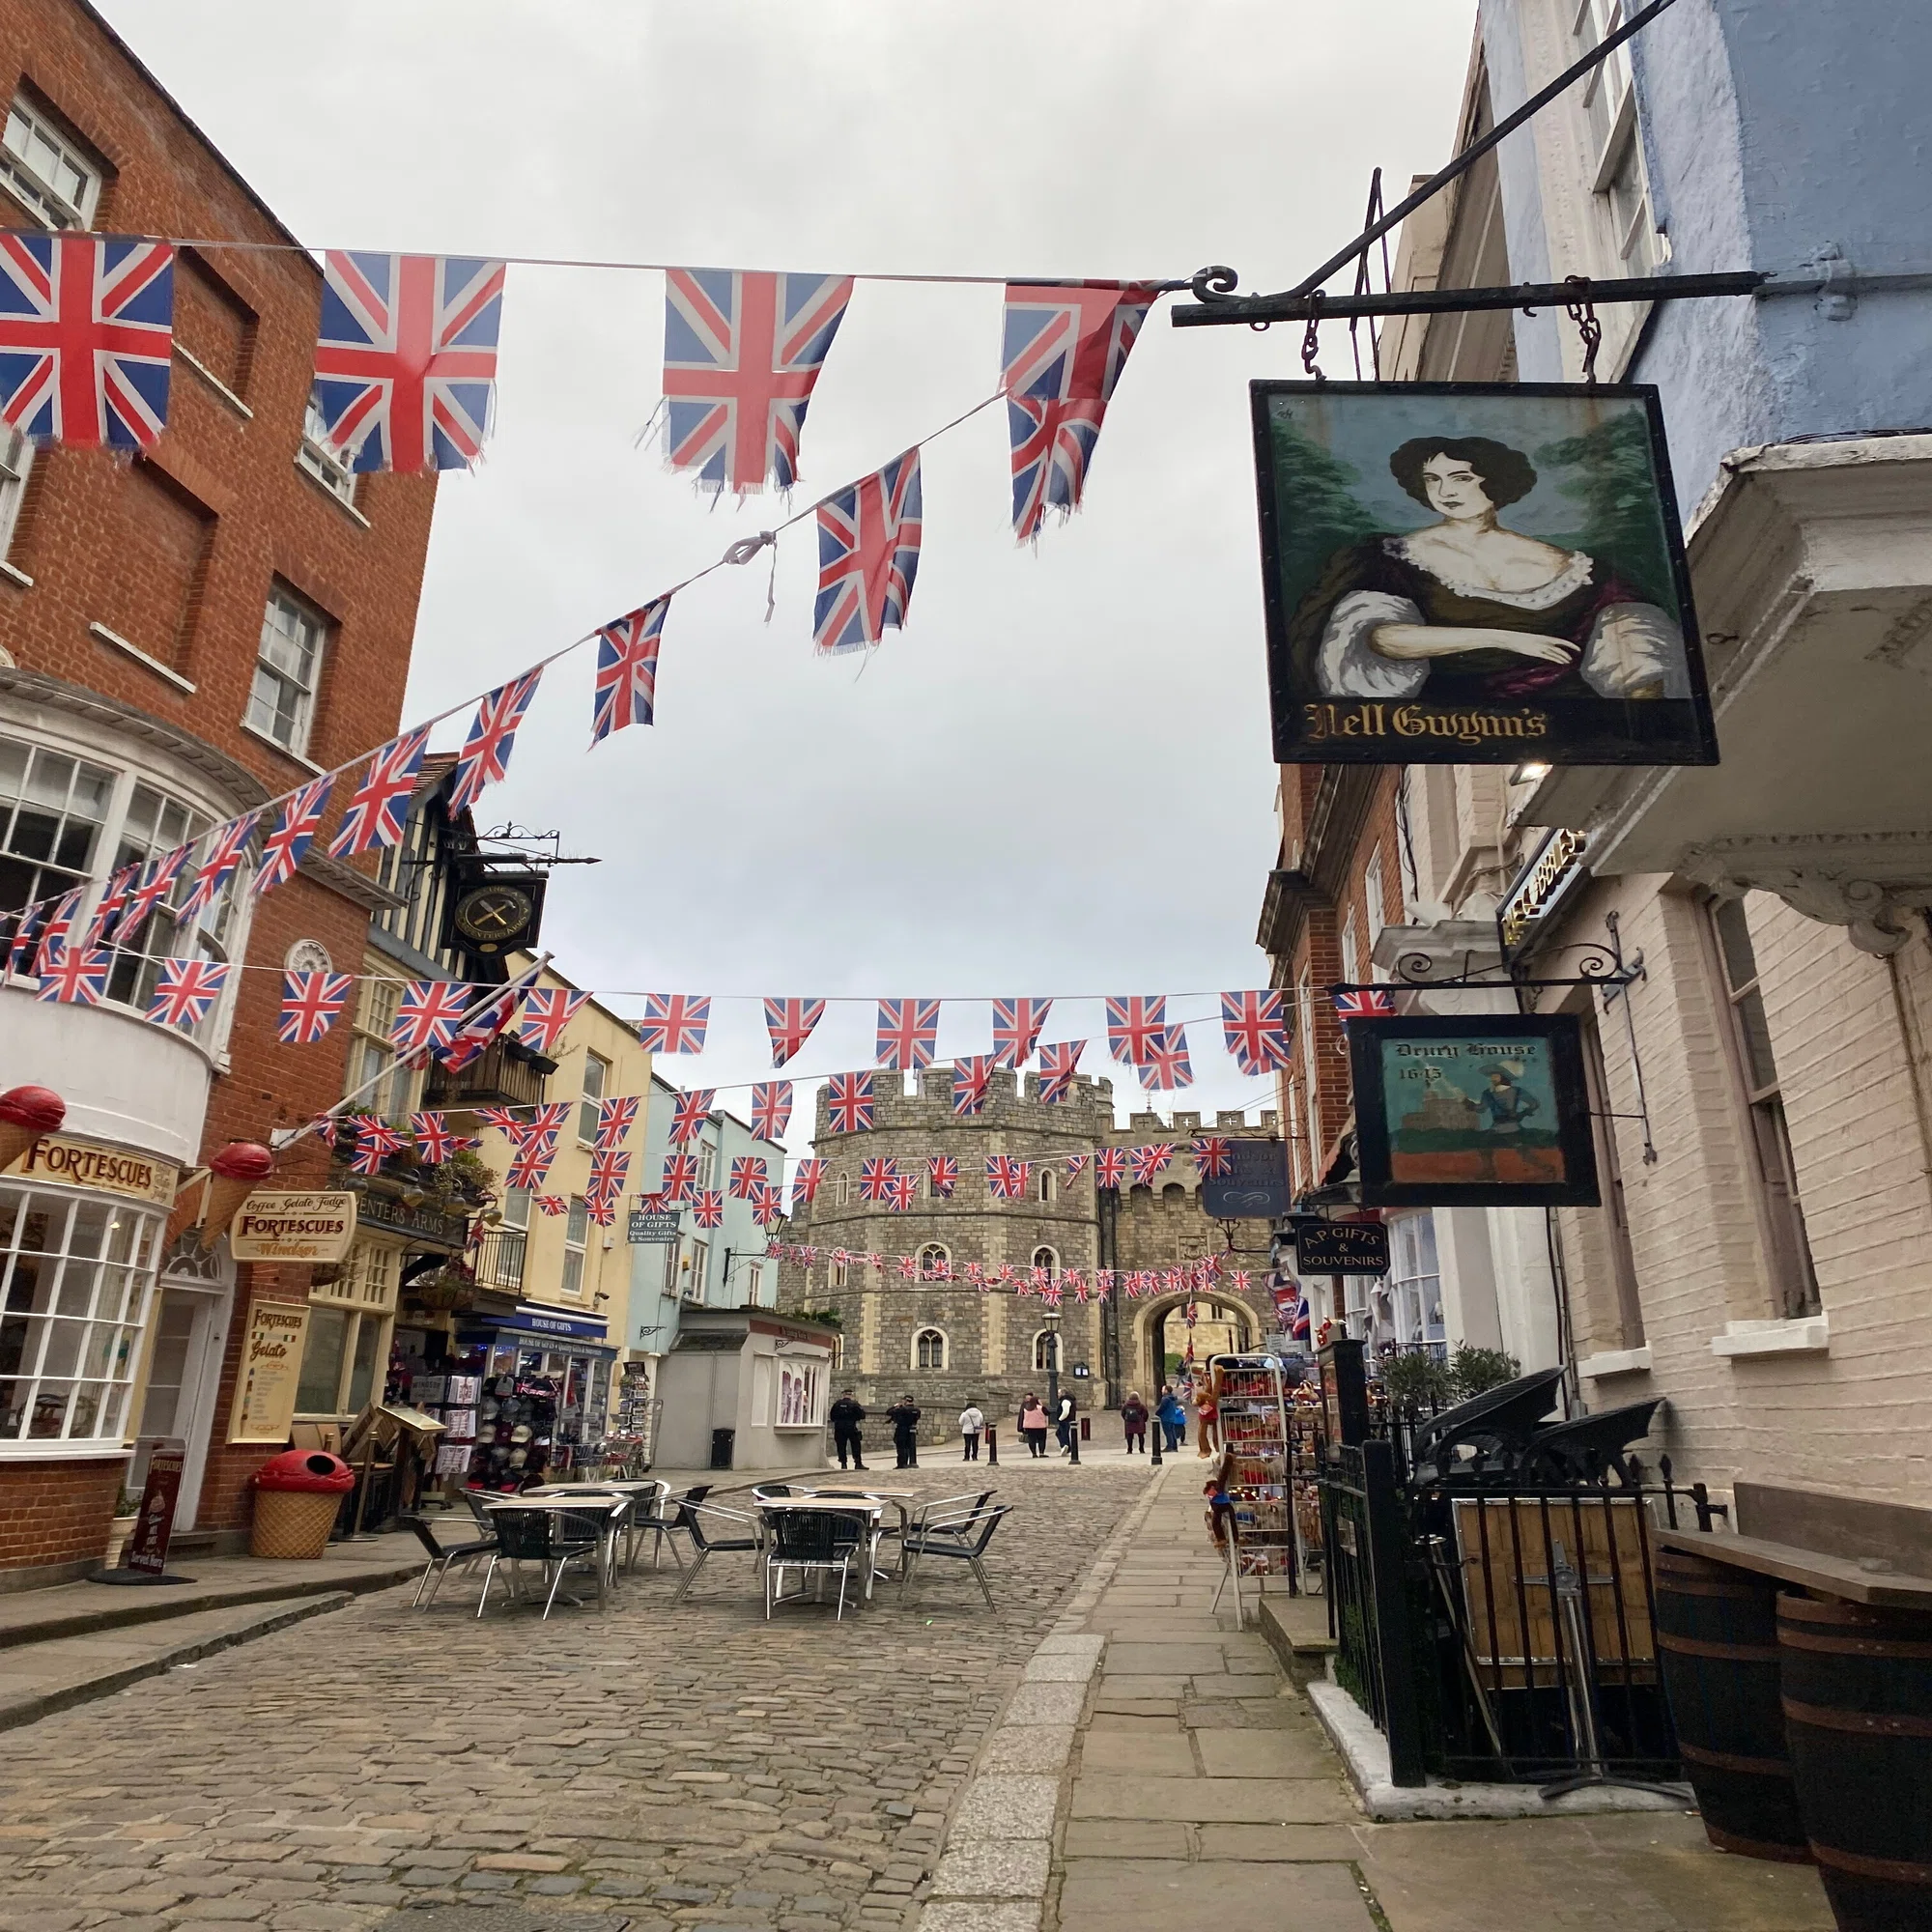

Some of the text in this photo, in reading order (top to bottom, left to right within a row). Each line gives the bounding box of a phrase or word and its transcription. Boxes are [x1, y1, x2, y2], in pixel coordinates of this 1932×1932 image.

[1304, 703, 1547, 746] Nell Gwynn's
[1395, 1042, 1537, 1060] Drury House
[20, 1138, 153, 1188] FORTESCUES
[246, 1195, 347, 1213] Coffee Gelato Fudge
[238, 1215, 345, 1237] FORTESCUES
[411, 1210, 444, 1236] ARMS
[1331, 1227, 1379, 1245] GIFTS
[255, 1241, 320, 1258] Windsor
[1338, 1242, 1349, 1253] &
[1303, 1256, 1384, 1266] SOUVENIRS
[251, 1308, 302, 1331] FORTESCUES
[531, 1318, 572, 1332] HOUSE OF GIFTS
[249, 1340, 288, 1362] Gelato
[518, 1337, 535, 1347] HOUSE
